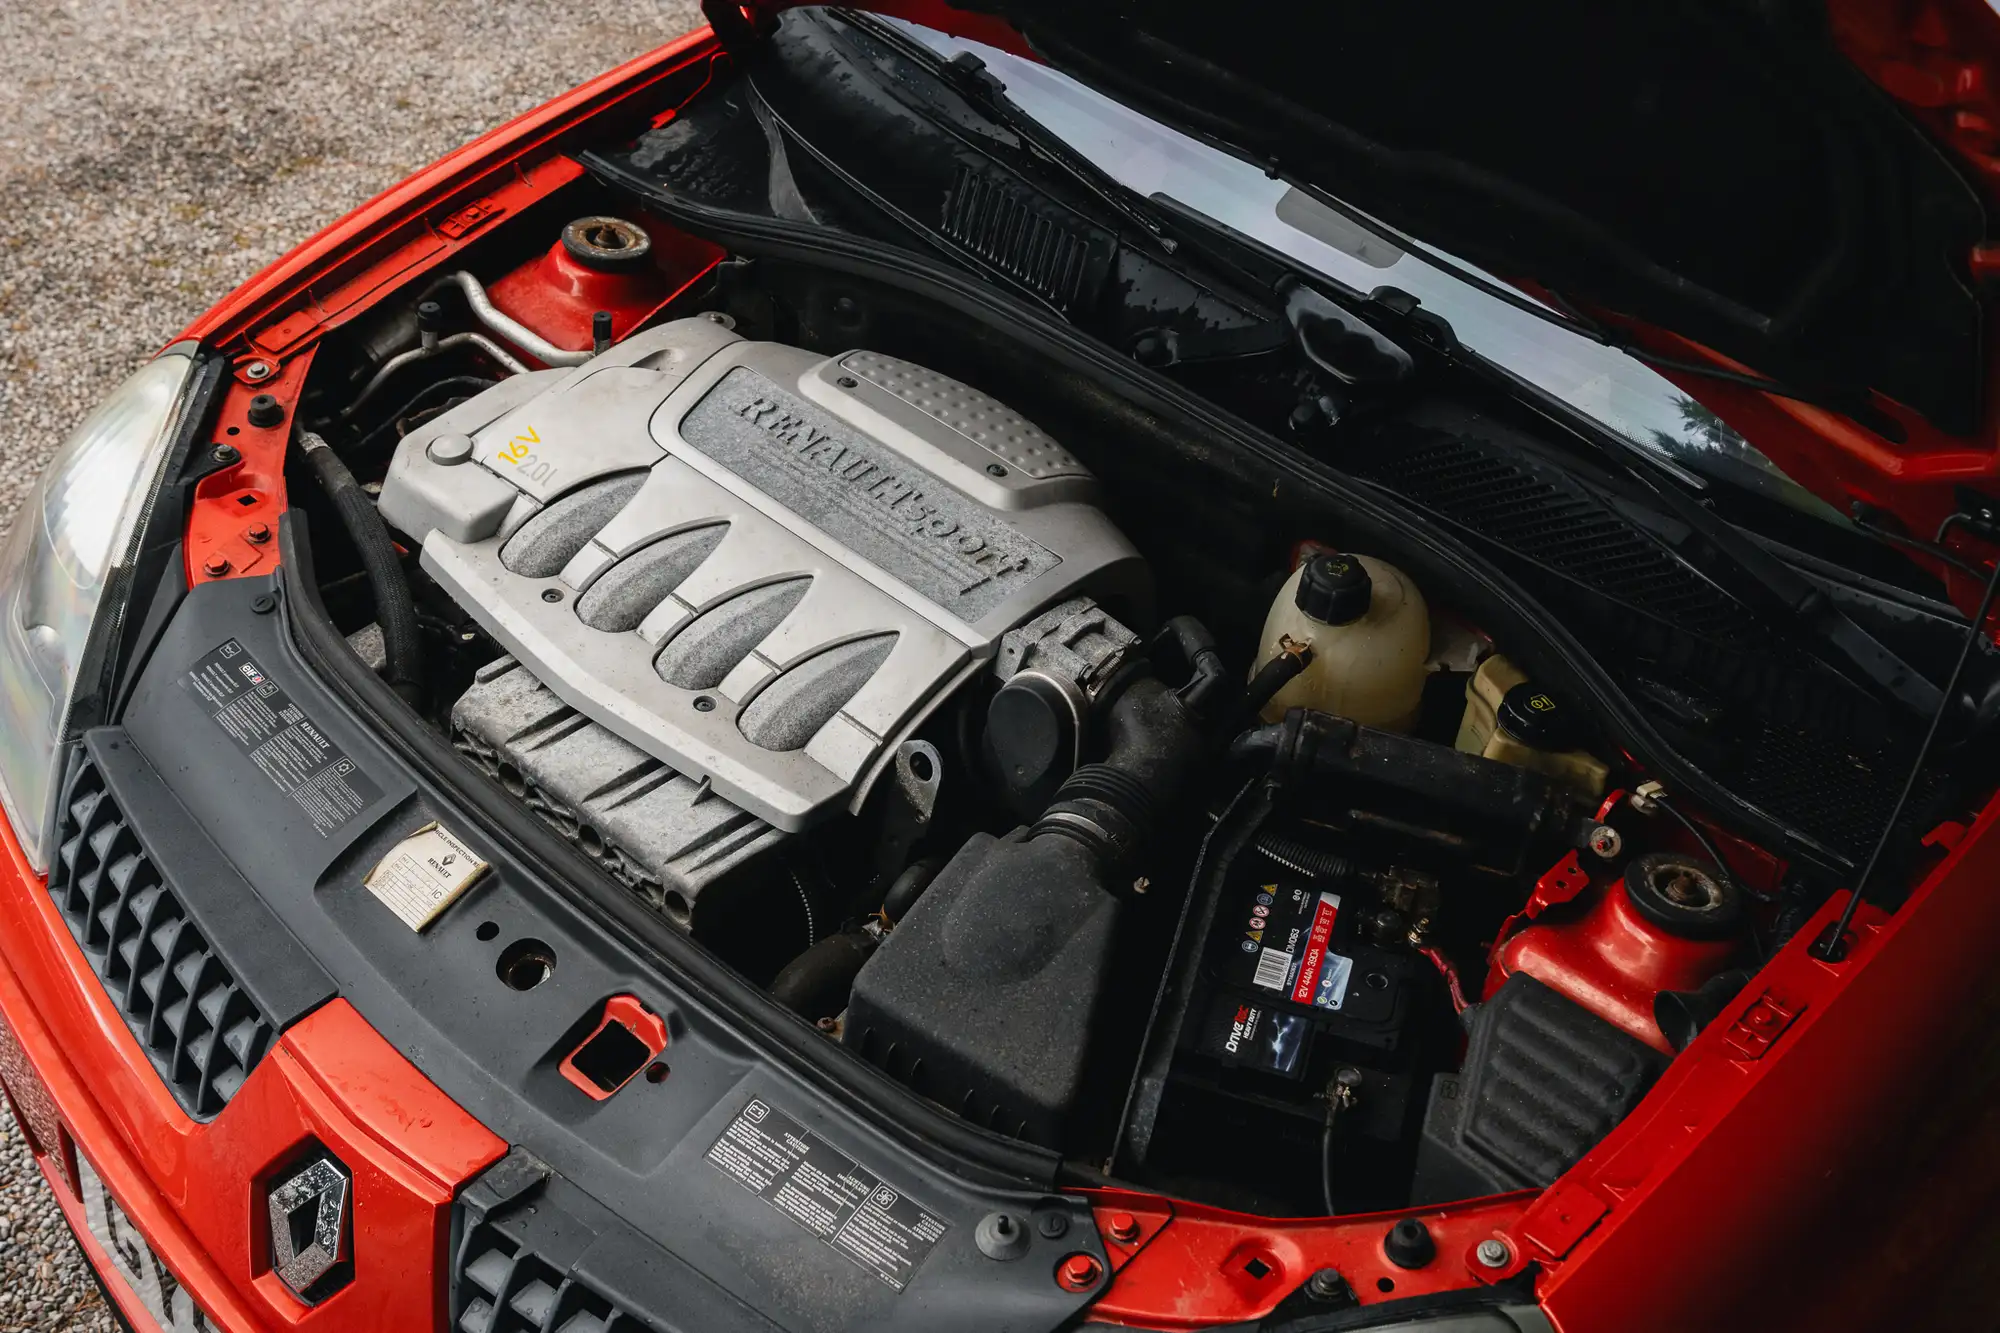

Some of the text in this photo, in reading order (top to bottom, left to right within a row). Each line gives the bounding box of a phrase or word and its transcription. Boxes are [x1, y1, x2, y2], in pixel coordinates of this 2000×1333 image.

[498, 425, 541, 465] 16V
[242, 665, 257, 678] elf
[300, 721, 331, 749] RENAULT
[446, 839, 474, 864] INSPECTION
[427, 857, 452, 879] RENAULT
[1298, 948, 1320, 998] 12V 44Ah 390A
[1247, 1007, 1257, 1022] DUTY
[1243, 1021, 1253, 1039] HEAVY
[783, 1131, 811, 1152] ATTENTION
